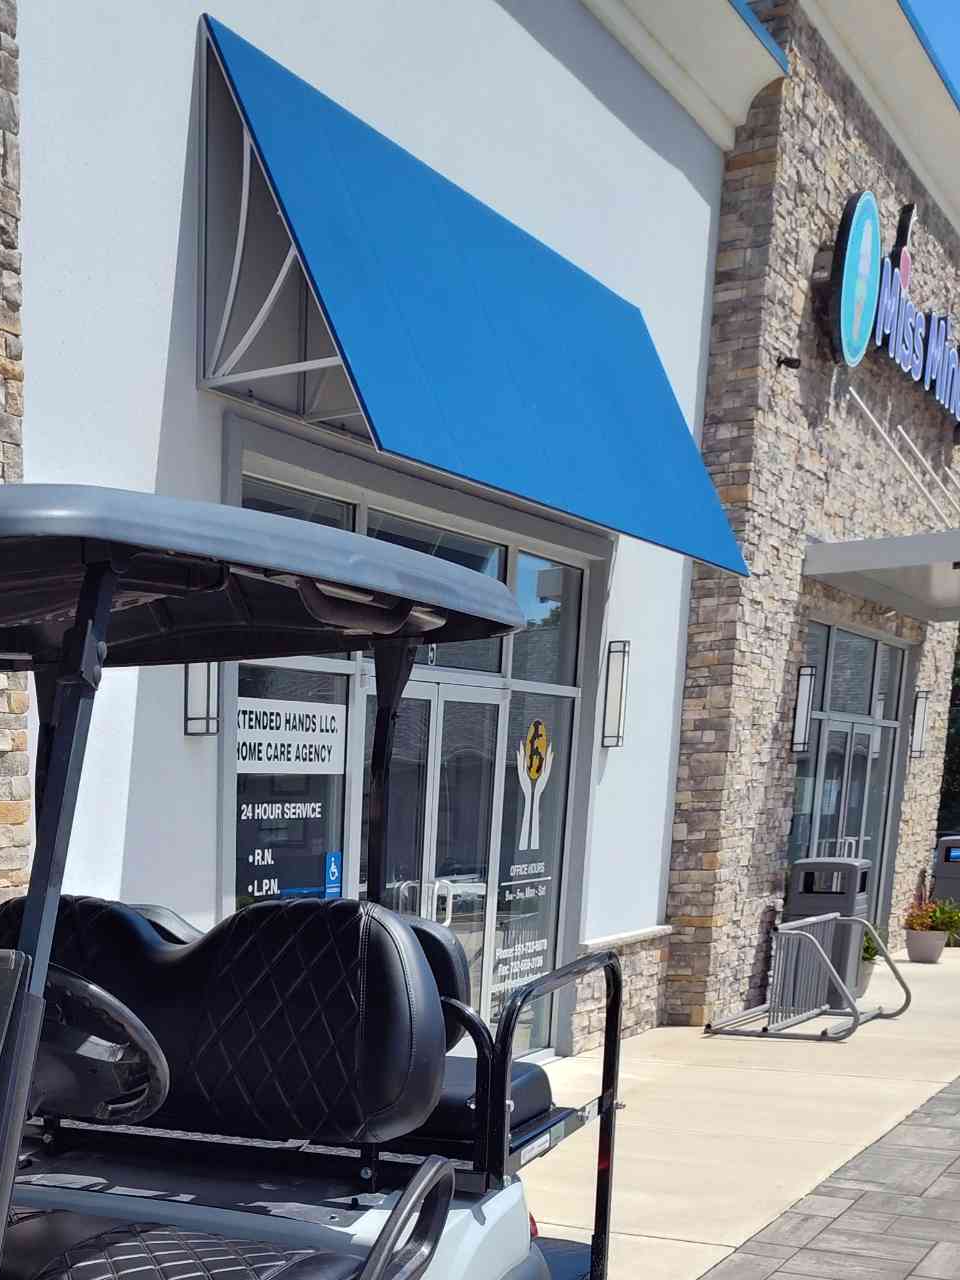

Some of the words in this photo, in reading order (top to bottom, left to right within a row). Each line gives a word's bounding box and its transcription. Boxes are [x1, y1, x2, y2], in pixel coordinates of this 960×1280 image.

[284, 711, 317, 733] HANDS
[319, 714, 338, 734] LLC.
[266, 742, 292, 762] CARE
[295, 743, 333, 763] AGENCY
[240, 803, 253, 820] 24
[254, 803, 282, 820] HOUR
[283, 802, 322, 819] SERVICE
[510, 863, 528, 876] OFFICE
